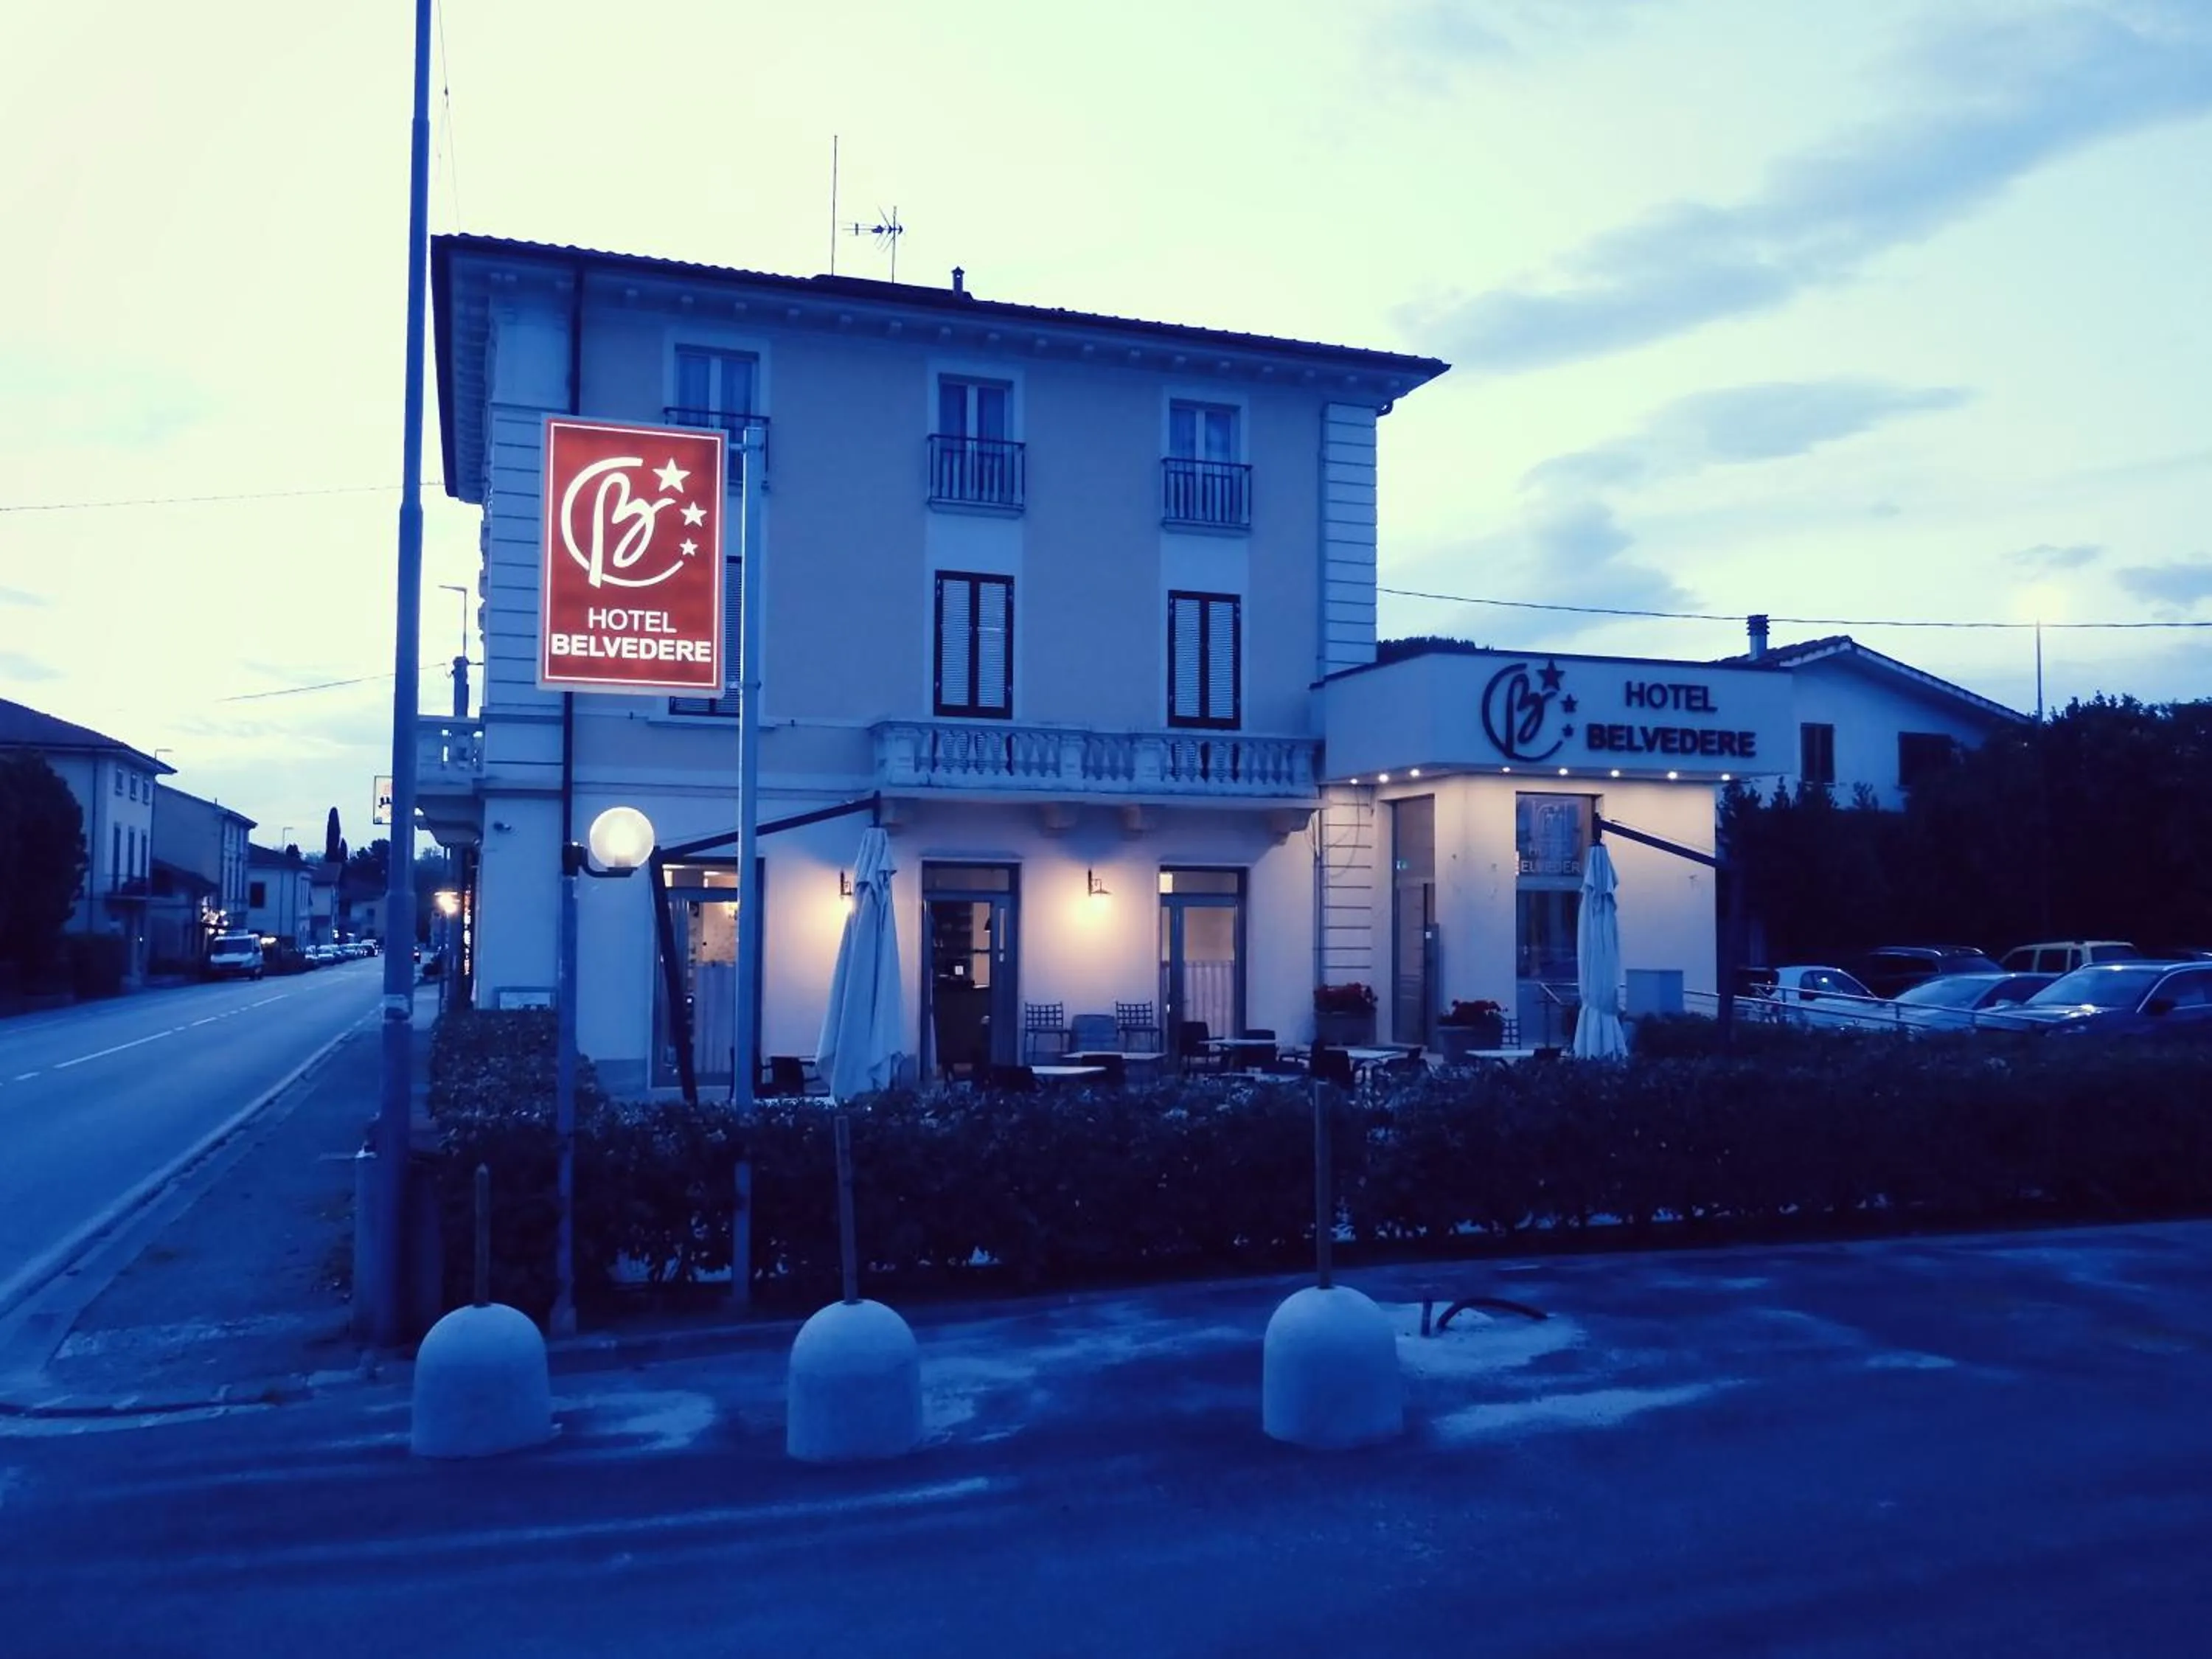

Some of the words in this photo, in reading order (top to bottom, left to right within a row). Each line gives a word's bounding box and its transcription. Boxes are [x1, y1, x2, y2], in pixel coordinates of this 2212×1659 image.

[588, 608, 677, 633] HOTEL
[552, 633, 712, 662] BELVEDERE
[1625, 681, 1718, 712] HOTEL
[1587, 723, 1756, 758] BELVEDERE
